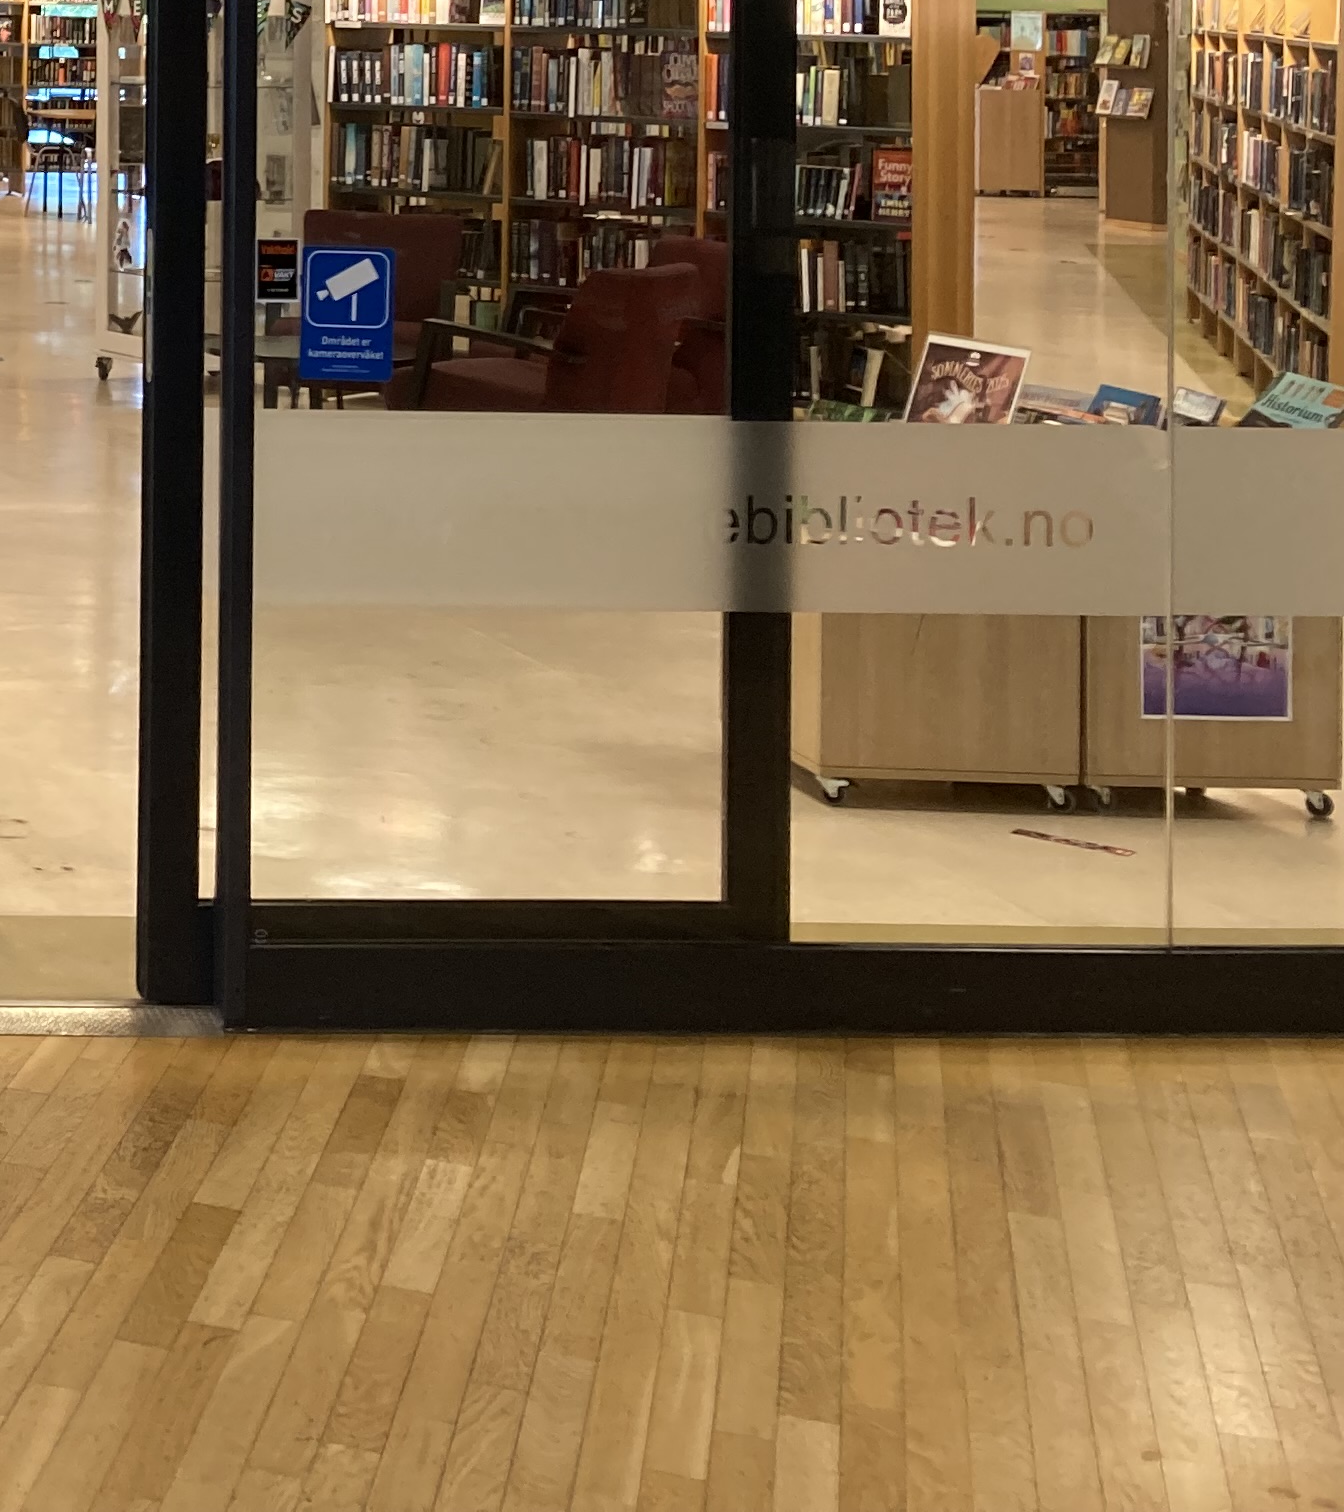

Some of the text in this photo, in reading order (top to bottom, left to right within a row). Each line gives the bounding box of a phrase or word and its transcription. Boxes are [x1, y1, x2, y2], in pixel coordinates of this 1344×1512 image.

[879, 159, 913, 172] Funny
[880, 171, 911, 186] Story
[322, 336, 372, 346] Området er
[308, 349, 384, 360] kameraovervåket
[1262, 394, 1323, 423] Historium
